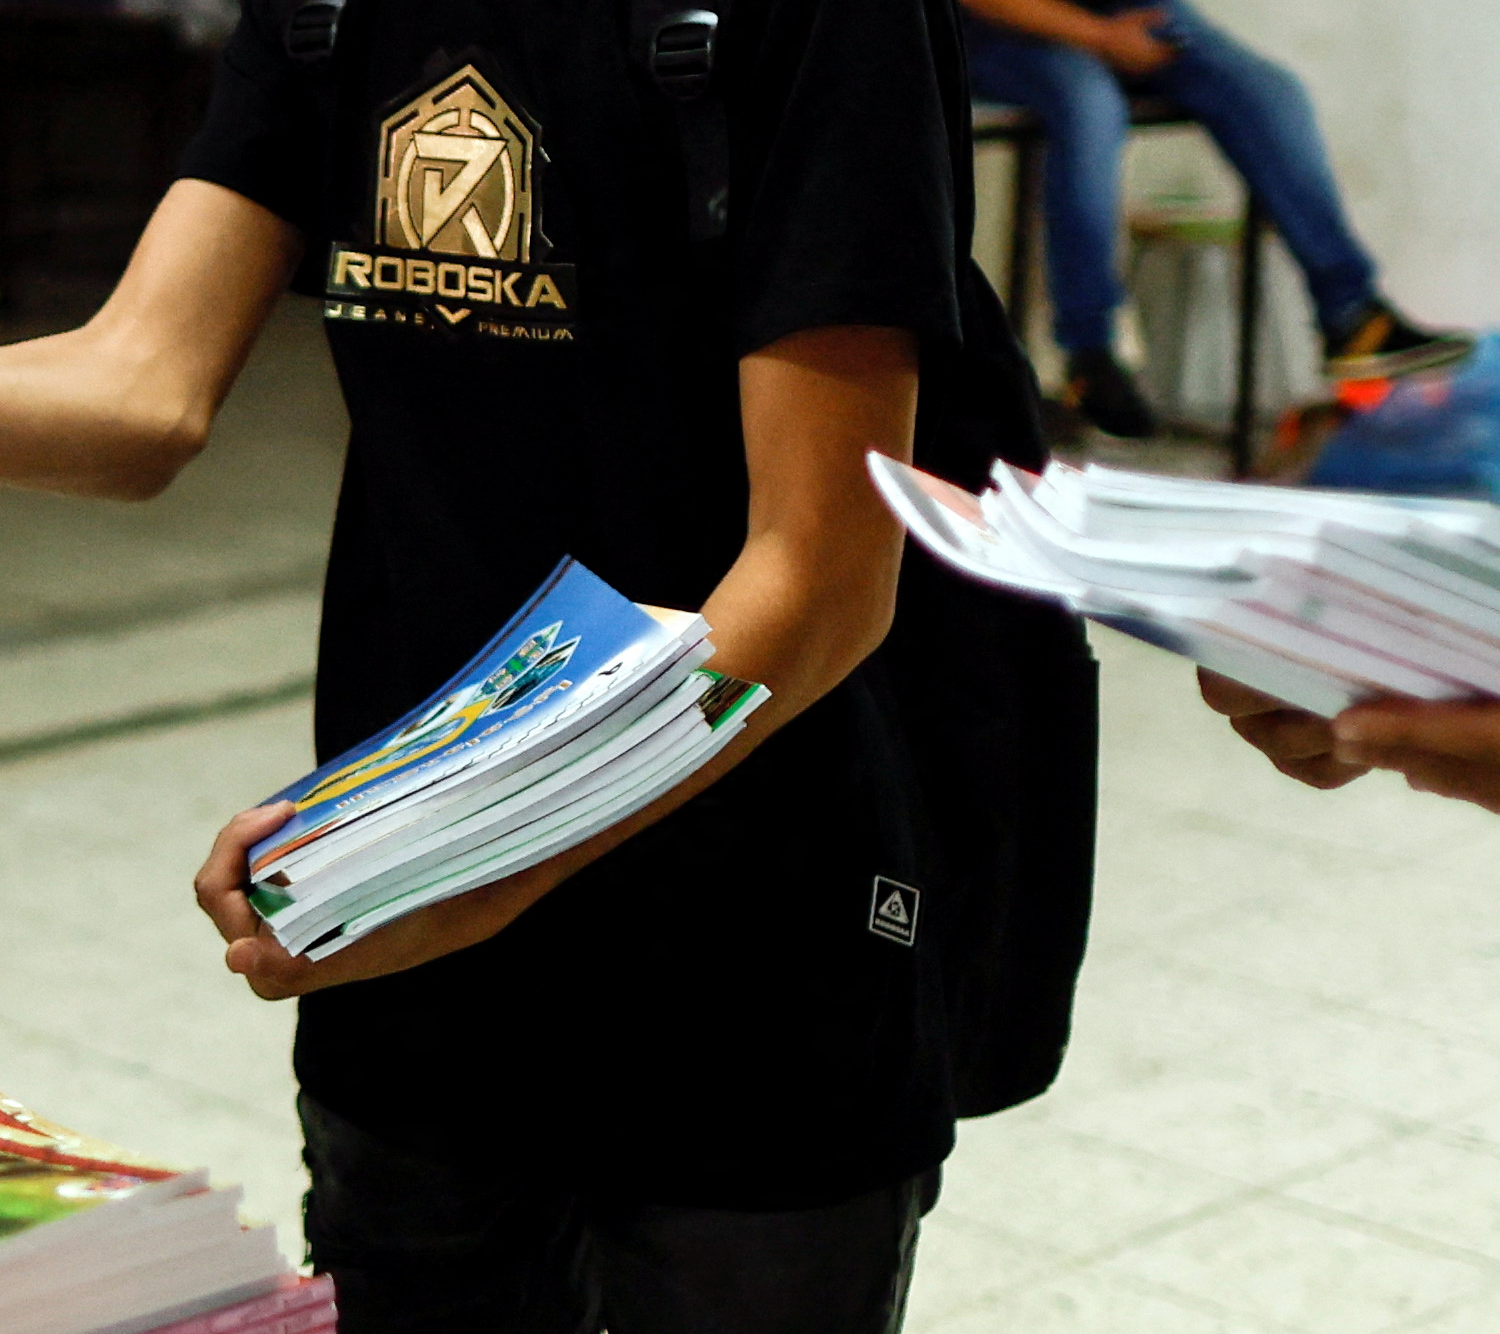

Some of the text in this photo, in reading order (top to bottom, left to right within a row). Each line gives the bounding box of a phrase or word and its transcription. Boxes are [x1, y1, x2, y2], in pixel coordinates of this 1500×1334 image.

[333, 251, 567, 310] ROBOSKA
[326, 303, 574, 341] JEANS PREMIUM
